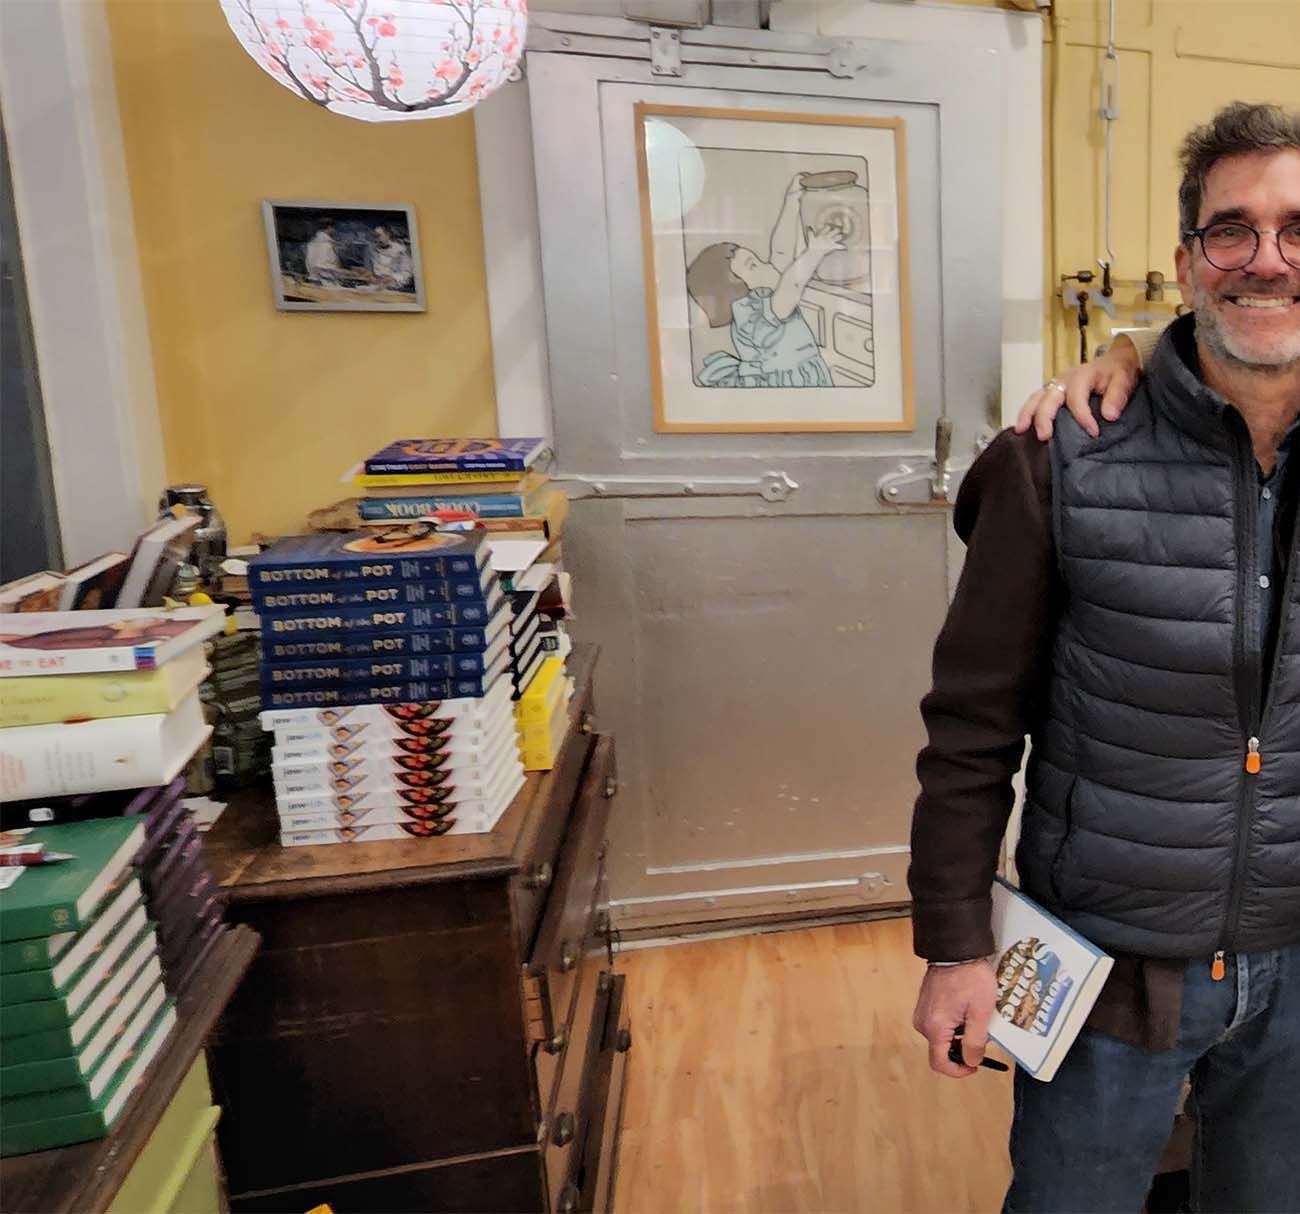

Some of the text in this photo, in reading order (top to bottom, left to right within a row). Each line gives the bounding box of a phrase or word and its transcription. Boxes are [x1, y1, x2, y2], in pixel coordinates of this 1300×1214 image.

[259, 568, 329, 582] BOTTOM
[361, 564, 394, 577] POT
[264, 592, 334, 607] BOTTOM
[365, 588, 399, 601] POT
[272, 616, 342, 632] BOTTOM
[372, 612, 407, 625] POT
[273, 642, 342, 656] BOTTOM
[372, 638, 405, 650] POT
[271, 667, 340, 681] BOTTOM
[371, 663, 404, 676] POT
[272, 691, 339, 705] BOTTOM
[370, 686, 402, 699] POT
